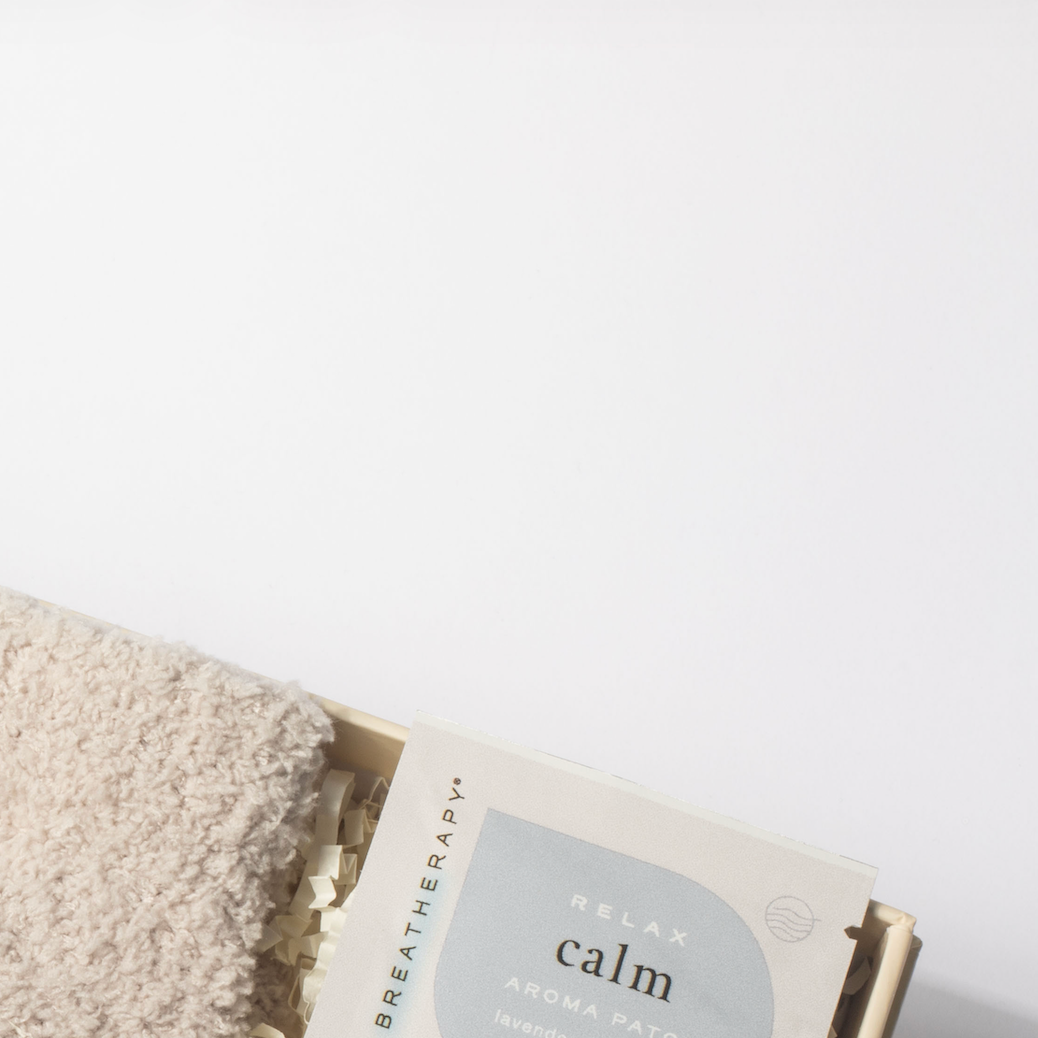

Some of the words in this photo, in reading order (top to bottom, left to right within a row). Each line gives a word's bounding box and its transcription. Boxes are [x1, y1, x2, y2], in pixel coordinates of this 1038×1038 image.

[570, 894, 688, 947] RELAX
[504, 976, 598, 1020] AROMA
[555, 939, 673, 1004] calm
